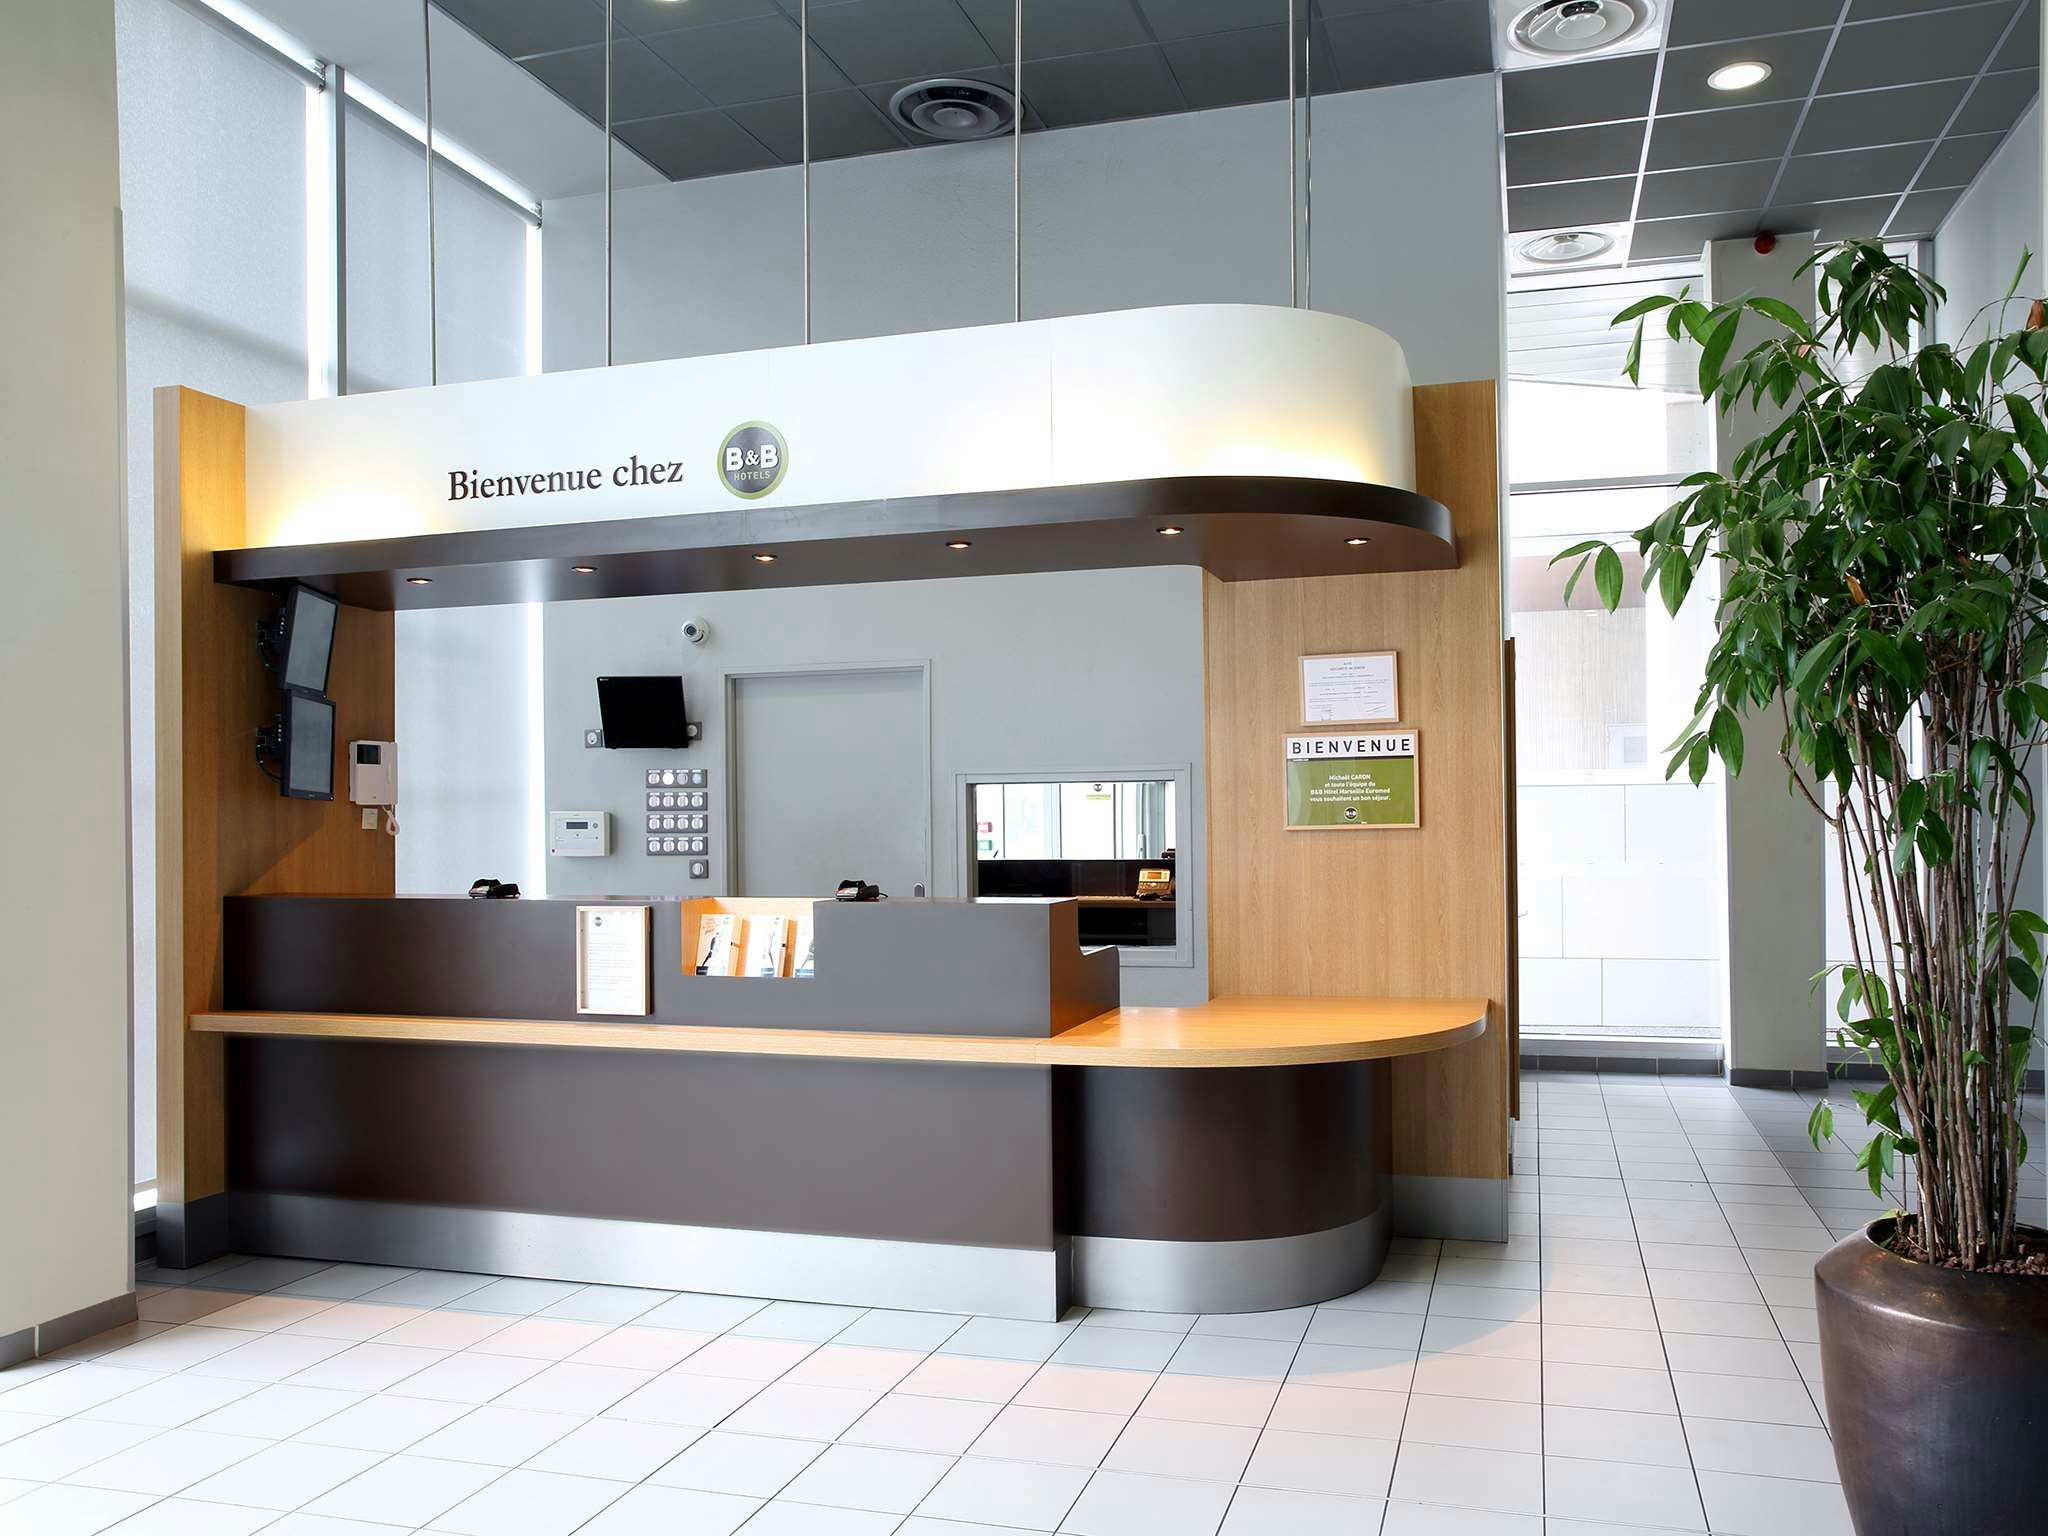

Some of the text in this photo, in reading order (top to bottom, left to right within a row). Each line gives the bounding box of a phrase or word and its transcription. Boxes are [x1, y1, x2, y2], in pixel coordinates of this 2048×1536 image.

[726, 444, 779, 471] B&B
[448, 455, 684, 501] Bienvenue chez
[734, 471, 770, 481] HOTELS
[1292, 739, 1410, 754] BIENVENUE
